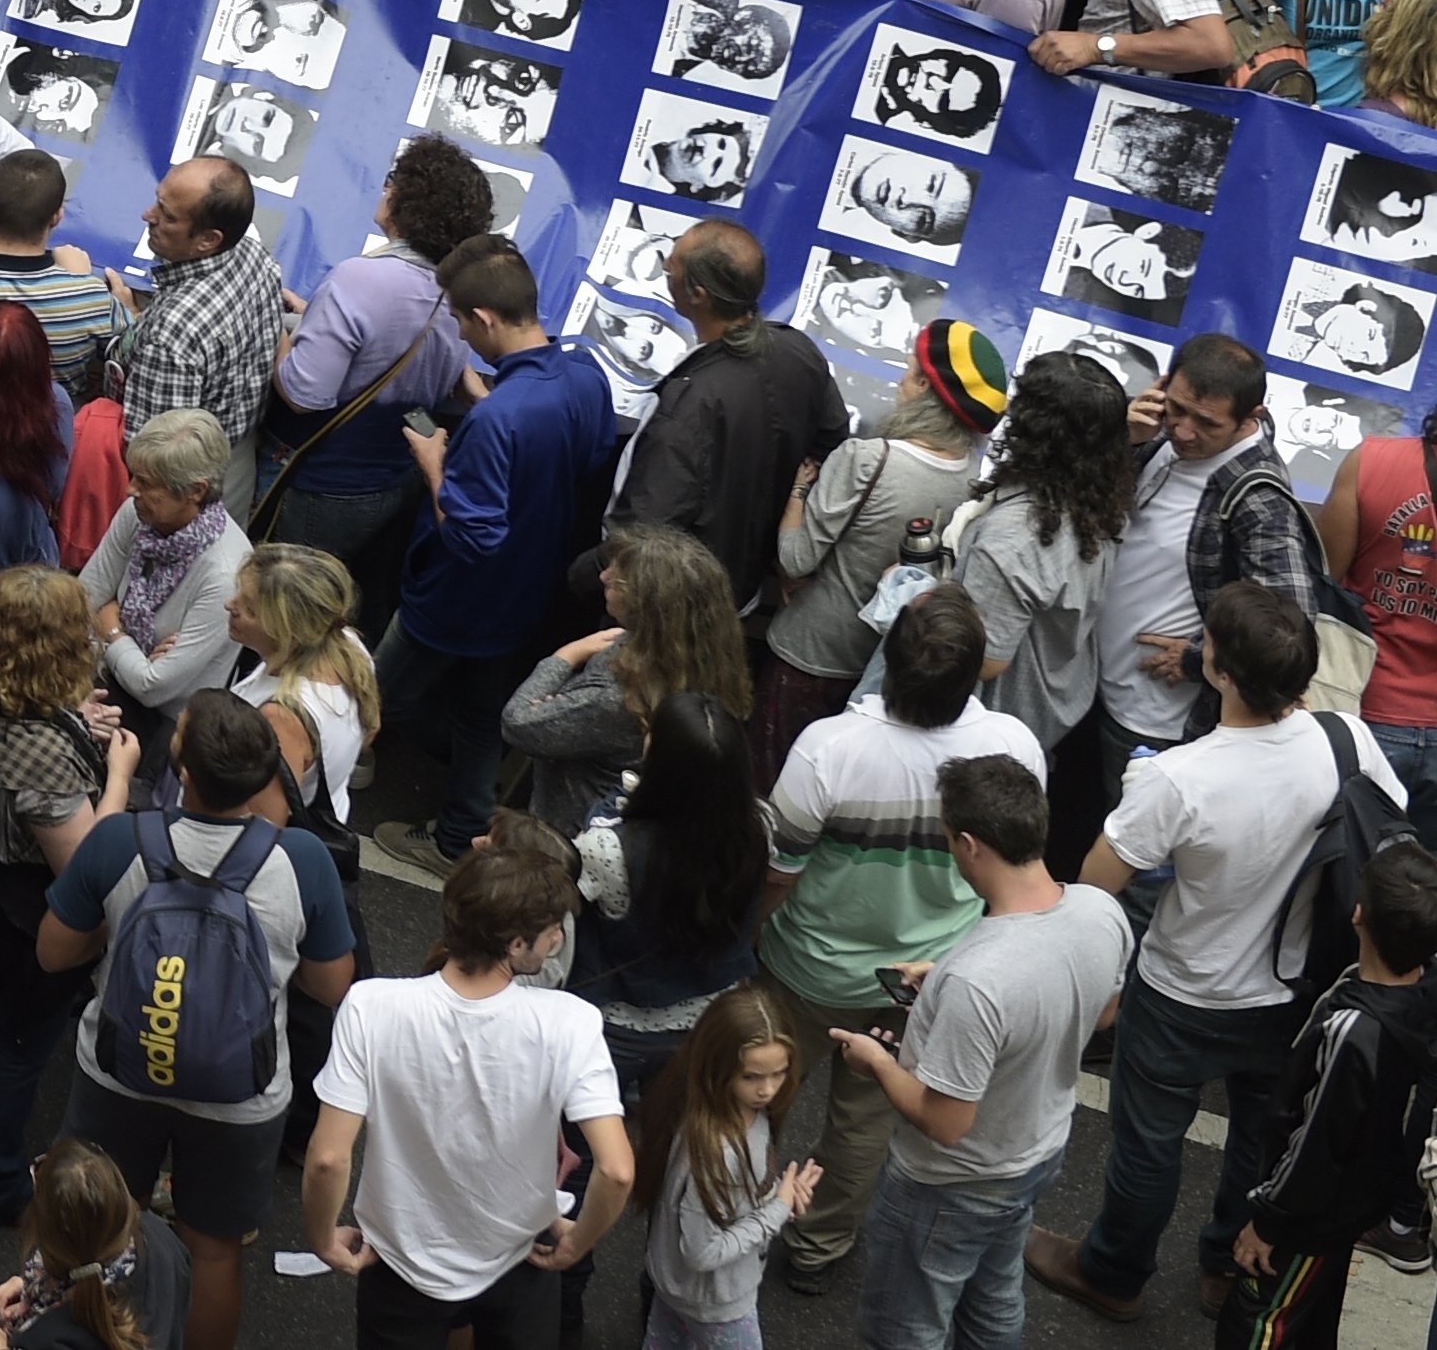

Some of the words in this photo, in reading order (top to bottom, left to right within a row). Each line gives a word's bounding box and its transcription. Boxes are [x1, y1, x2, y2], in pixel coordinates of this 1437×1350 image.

[1382, 492, 1430, 538] BATALLA
[1373, 568, 1393, 591] YO
[1396, 572, 1428, 596] SOY
[1371, 591, 1396, 613] LOS
[1399, 599, 1416, 616] 10
[139, 955, 186, 1086] adidas
